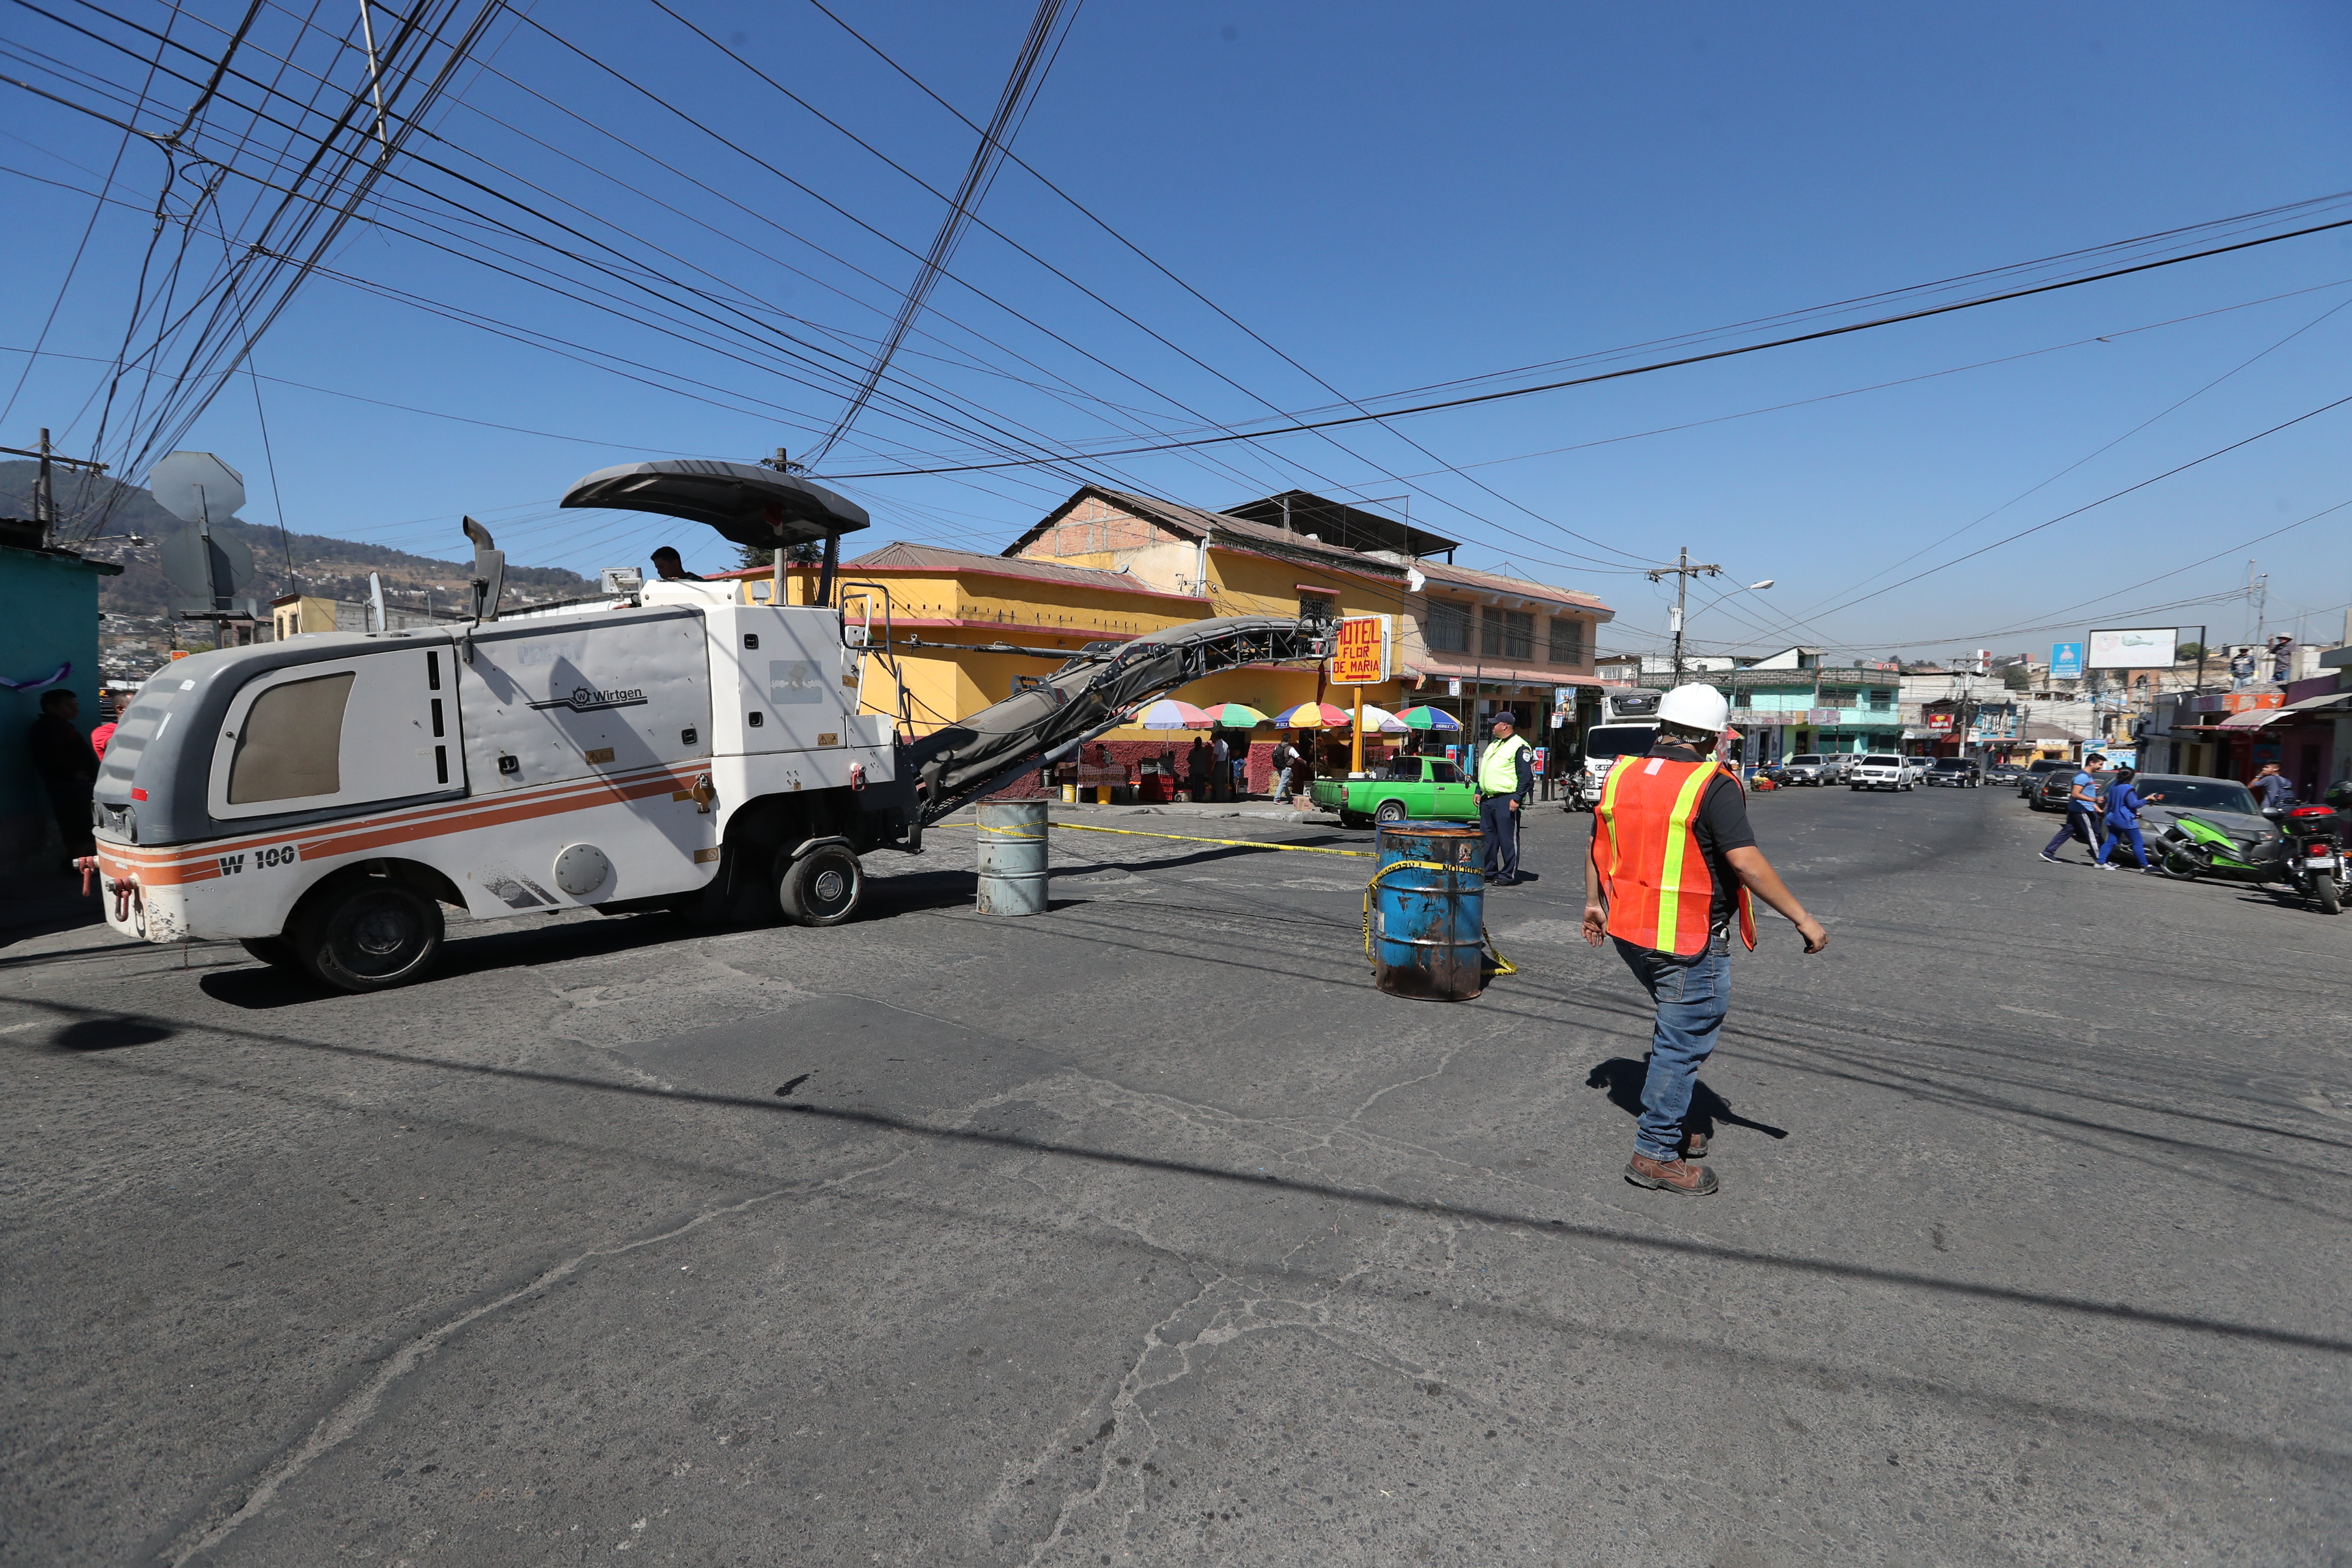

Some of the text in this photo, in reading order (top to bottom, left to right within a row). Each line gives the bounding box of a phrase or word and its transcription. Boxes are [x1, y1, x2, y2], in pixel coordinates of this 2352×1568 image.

[1343, 646, 1369, 659] FLOR
[1333, 660, 1380, 673] DE MARIA
[593, 689, 642, 702] Wirtgen
[219, 845, 295, 876] W 100
